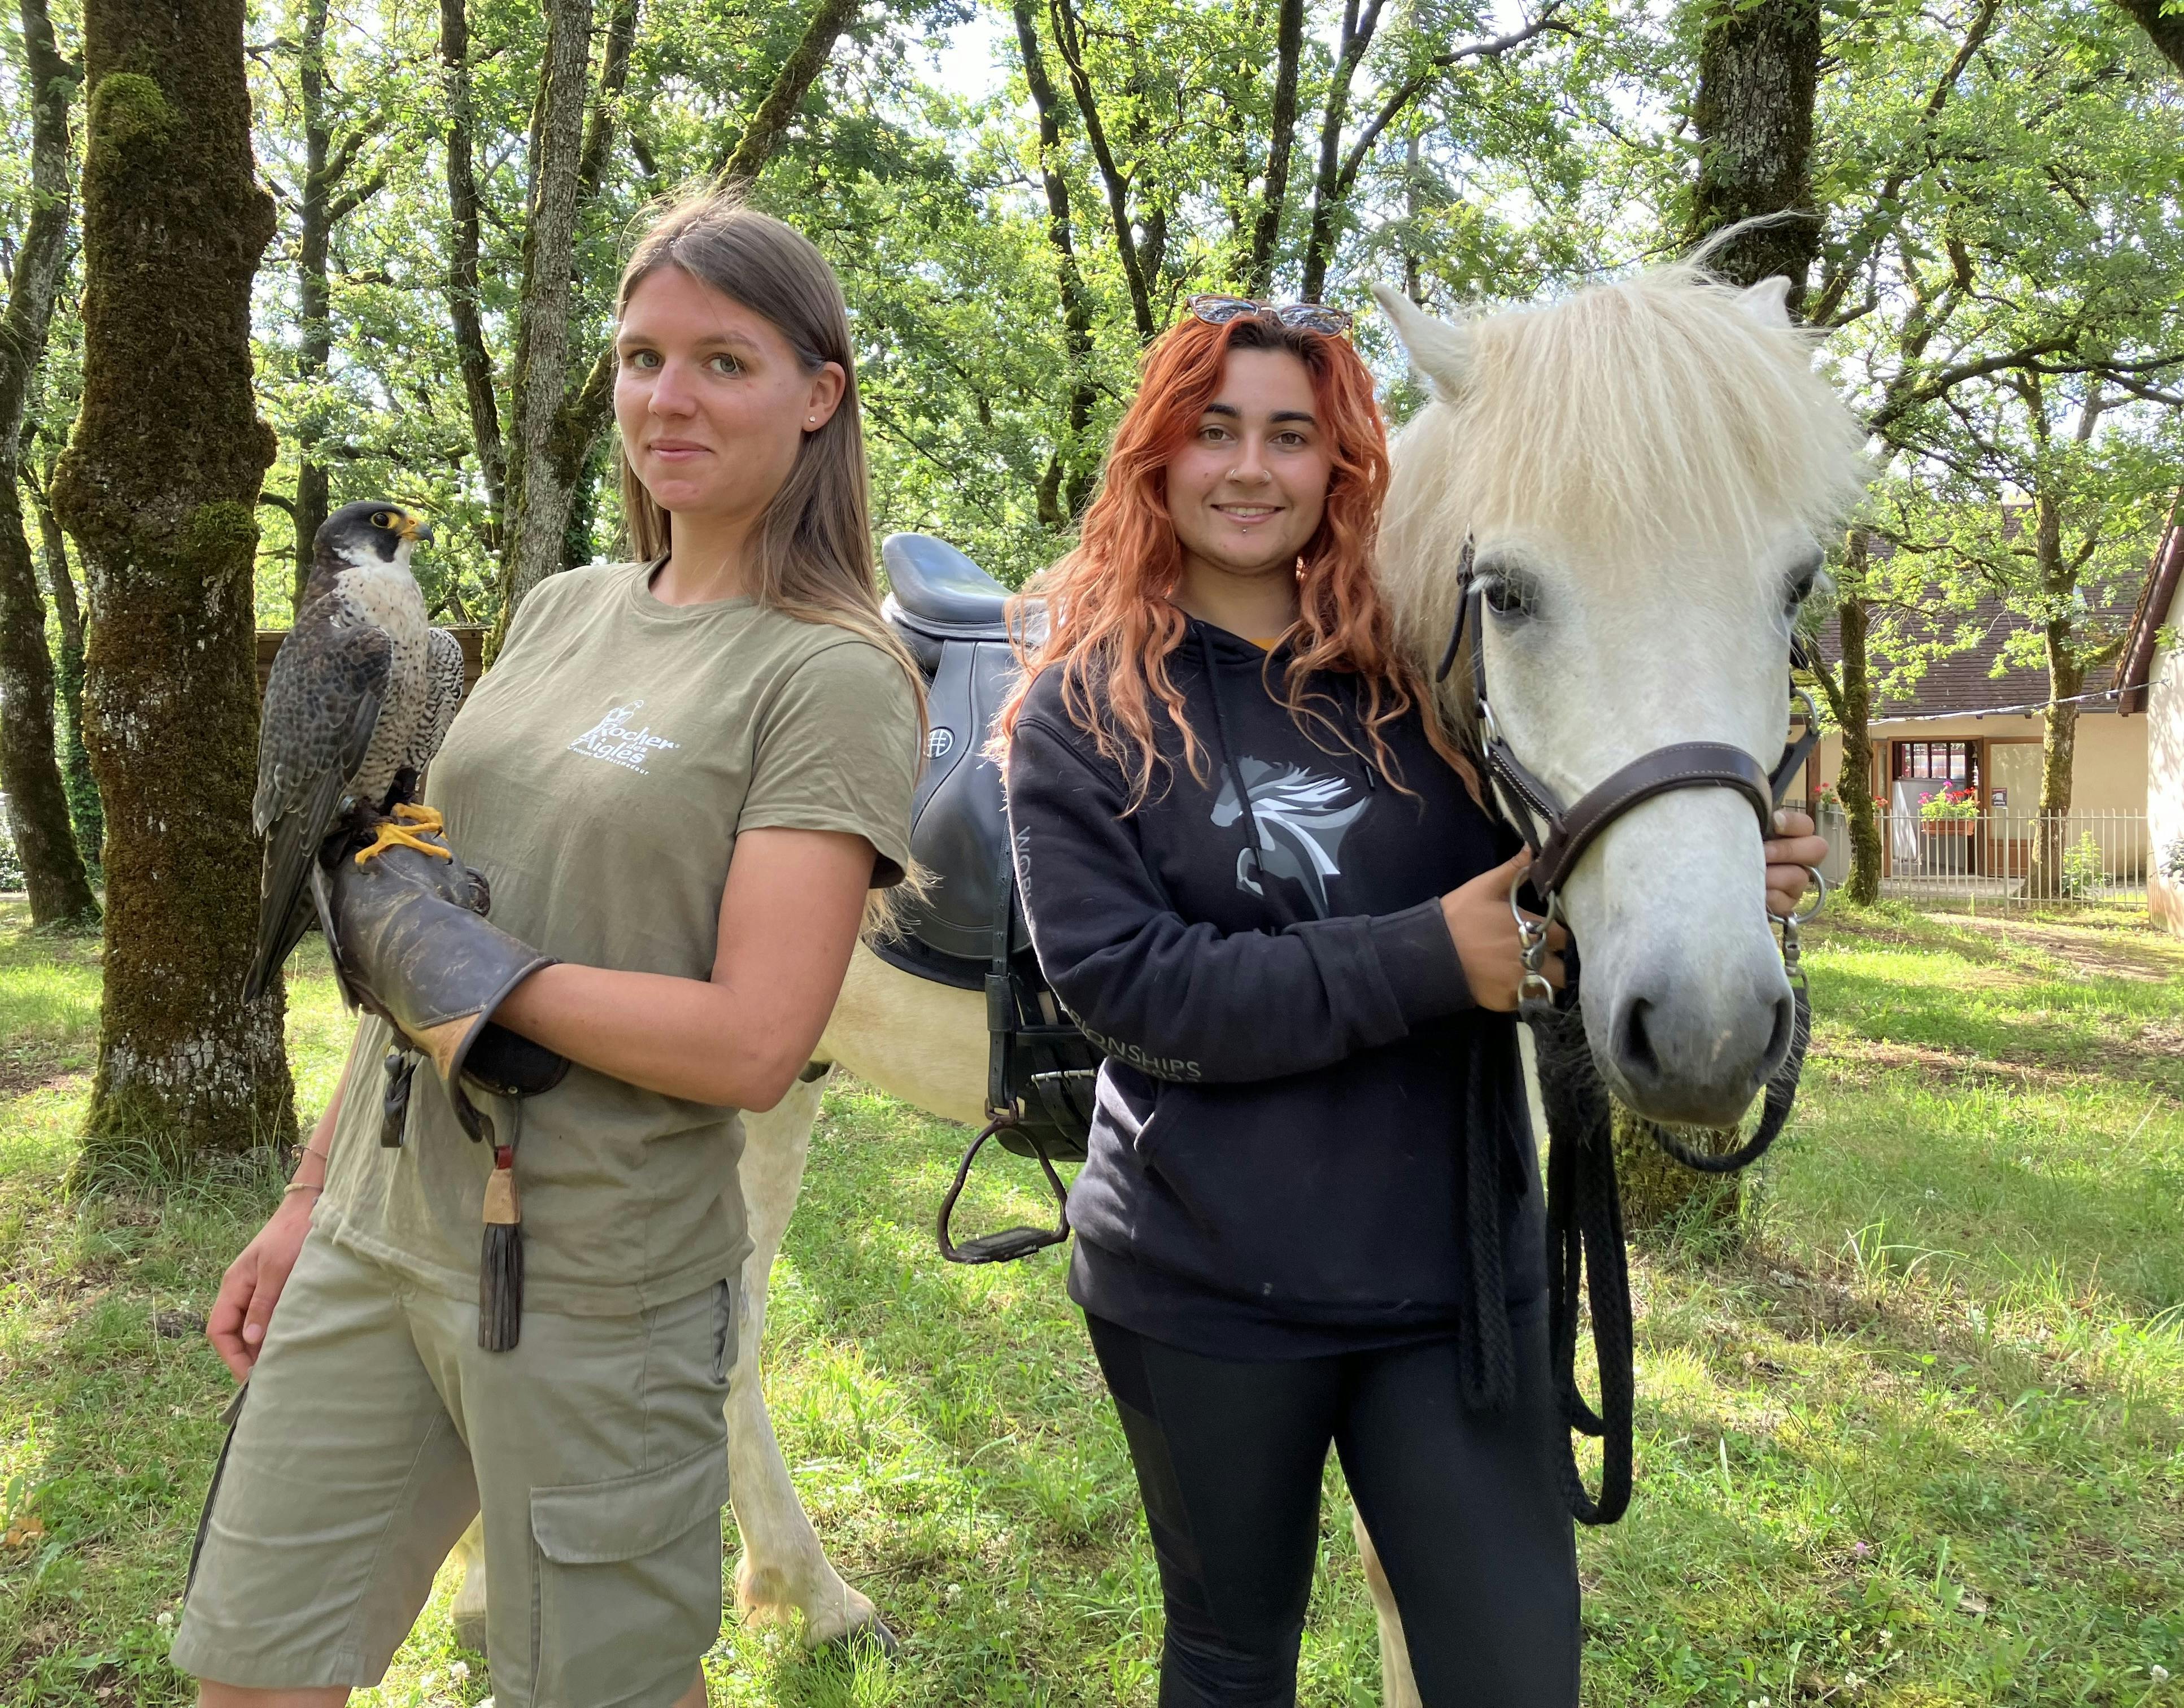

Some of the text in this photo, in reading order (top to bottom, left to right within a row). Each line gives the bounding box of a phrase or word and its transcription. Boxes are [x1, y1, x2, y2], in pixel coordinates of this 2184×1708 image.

[572, 733, 645, 764] Aigles
[595, 723, 674, 750] Rocher
[626, 742, 648, 752] des
[1070, 1009, 1201, 1078] PIONSHIPS
